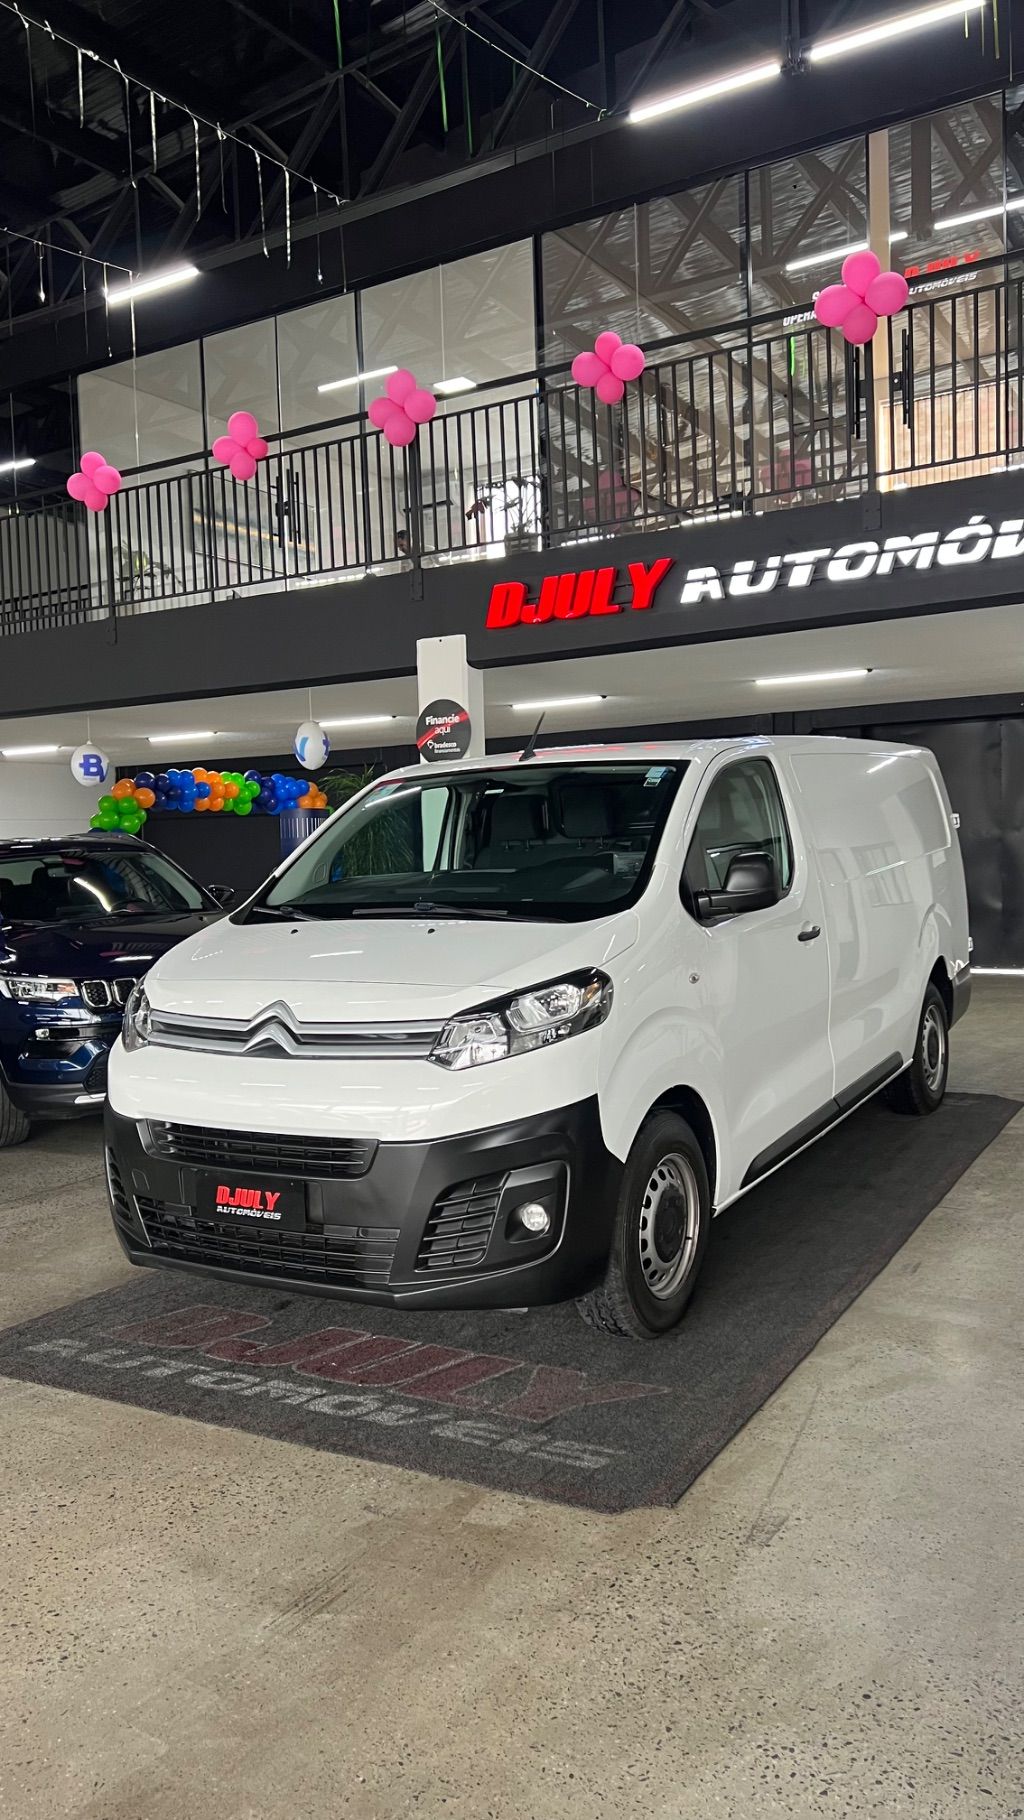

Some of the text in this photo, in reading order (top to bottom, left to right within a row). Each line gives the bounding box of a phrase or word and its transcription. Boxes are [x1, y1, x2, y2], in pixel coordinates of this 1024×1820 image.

[908, 271, 978, 295] UTOMÓVEIS
[425, 714, 460, 726] Financie
[434, 725, 451, 736] aqui
[216, 1205, 282, 1220] AUTOMÓVEIS
